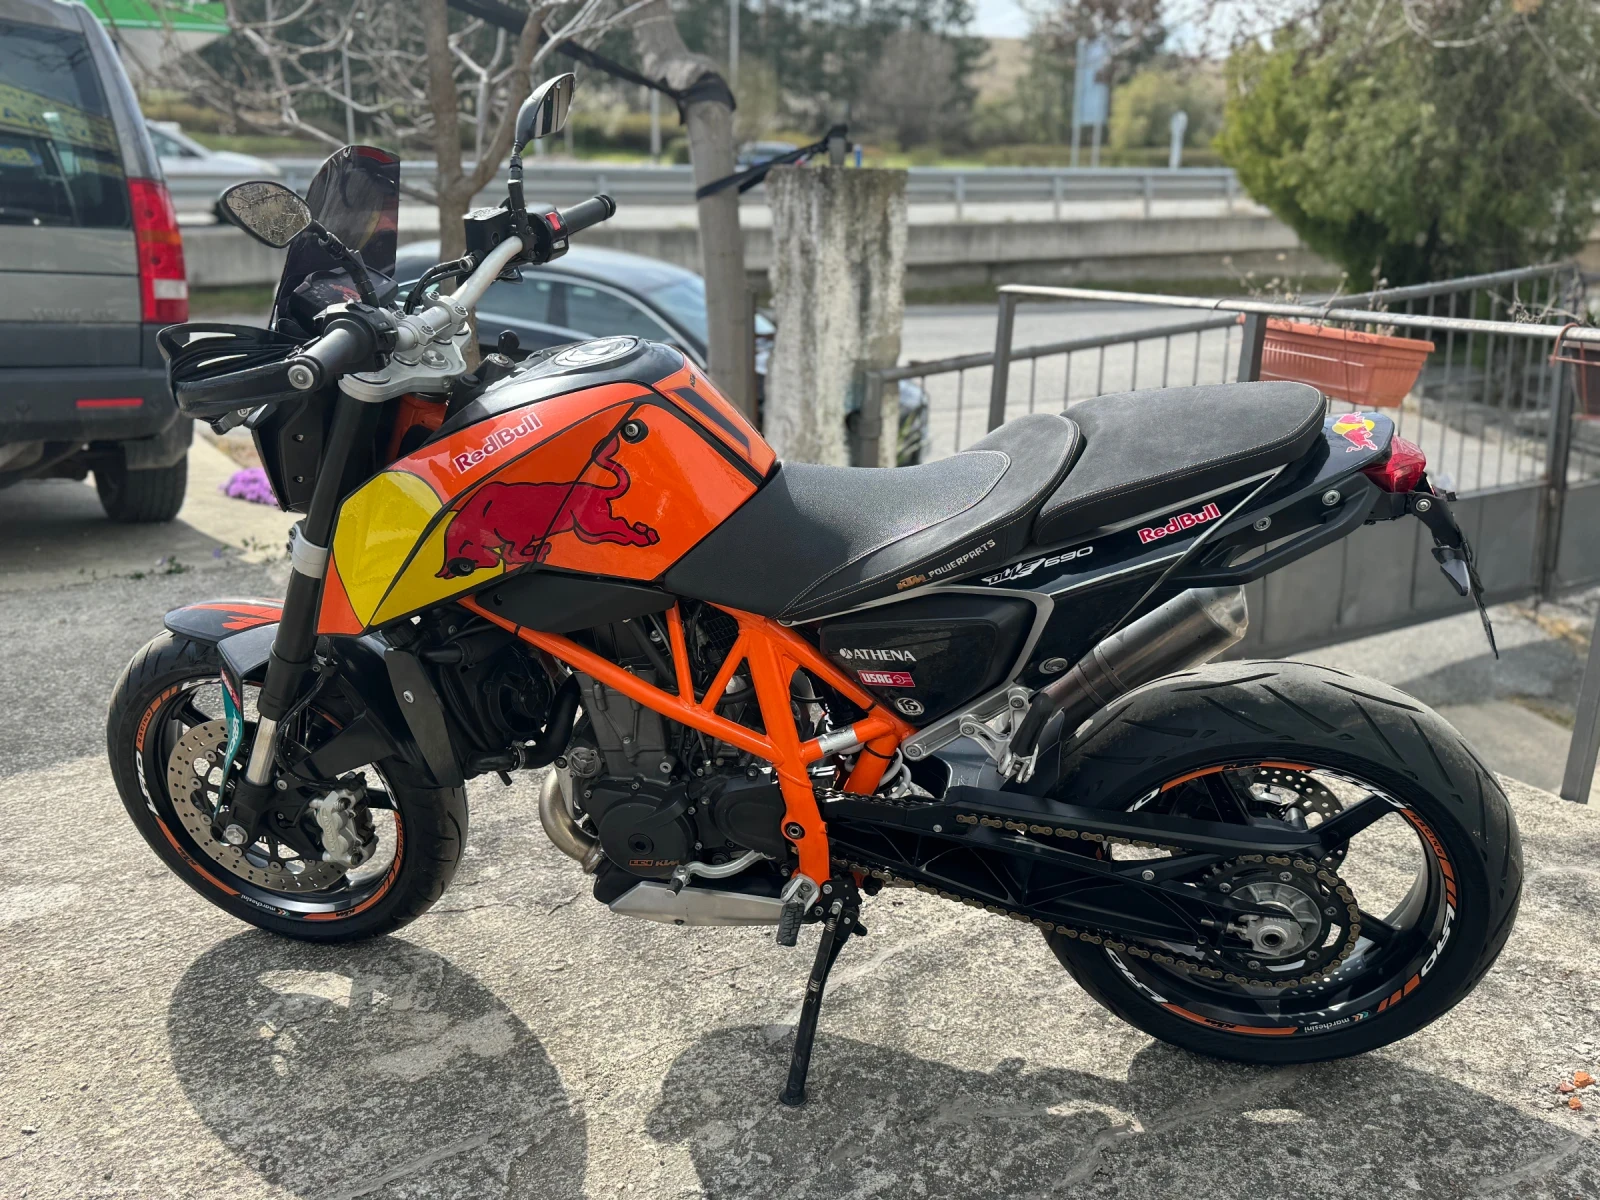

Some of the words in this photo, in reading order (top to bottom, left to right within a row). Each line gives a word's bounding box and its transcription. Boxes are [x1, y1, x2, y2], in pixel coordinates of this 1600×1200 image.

[454, 435, 500, 473] Red
[496, 413, 542, 448] Bull
[1138, 517, 1179, 544] Red
[1178, 503, 1221, 532] Bull
[928, 539, 996, 578] POWERPARTS
[1044, 546, 1093, 568] 690
[854, 648, 917, 662] ATHENA
[861, 673, 894, 684] USAG
[137, 712, 151, 744] RACING
[1410, 813, 1443, 855] RACING
[240, 894, 277, 912] marchesini
[1304, 1016, 1351, 1034] marchesini
